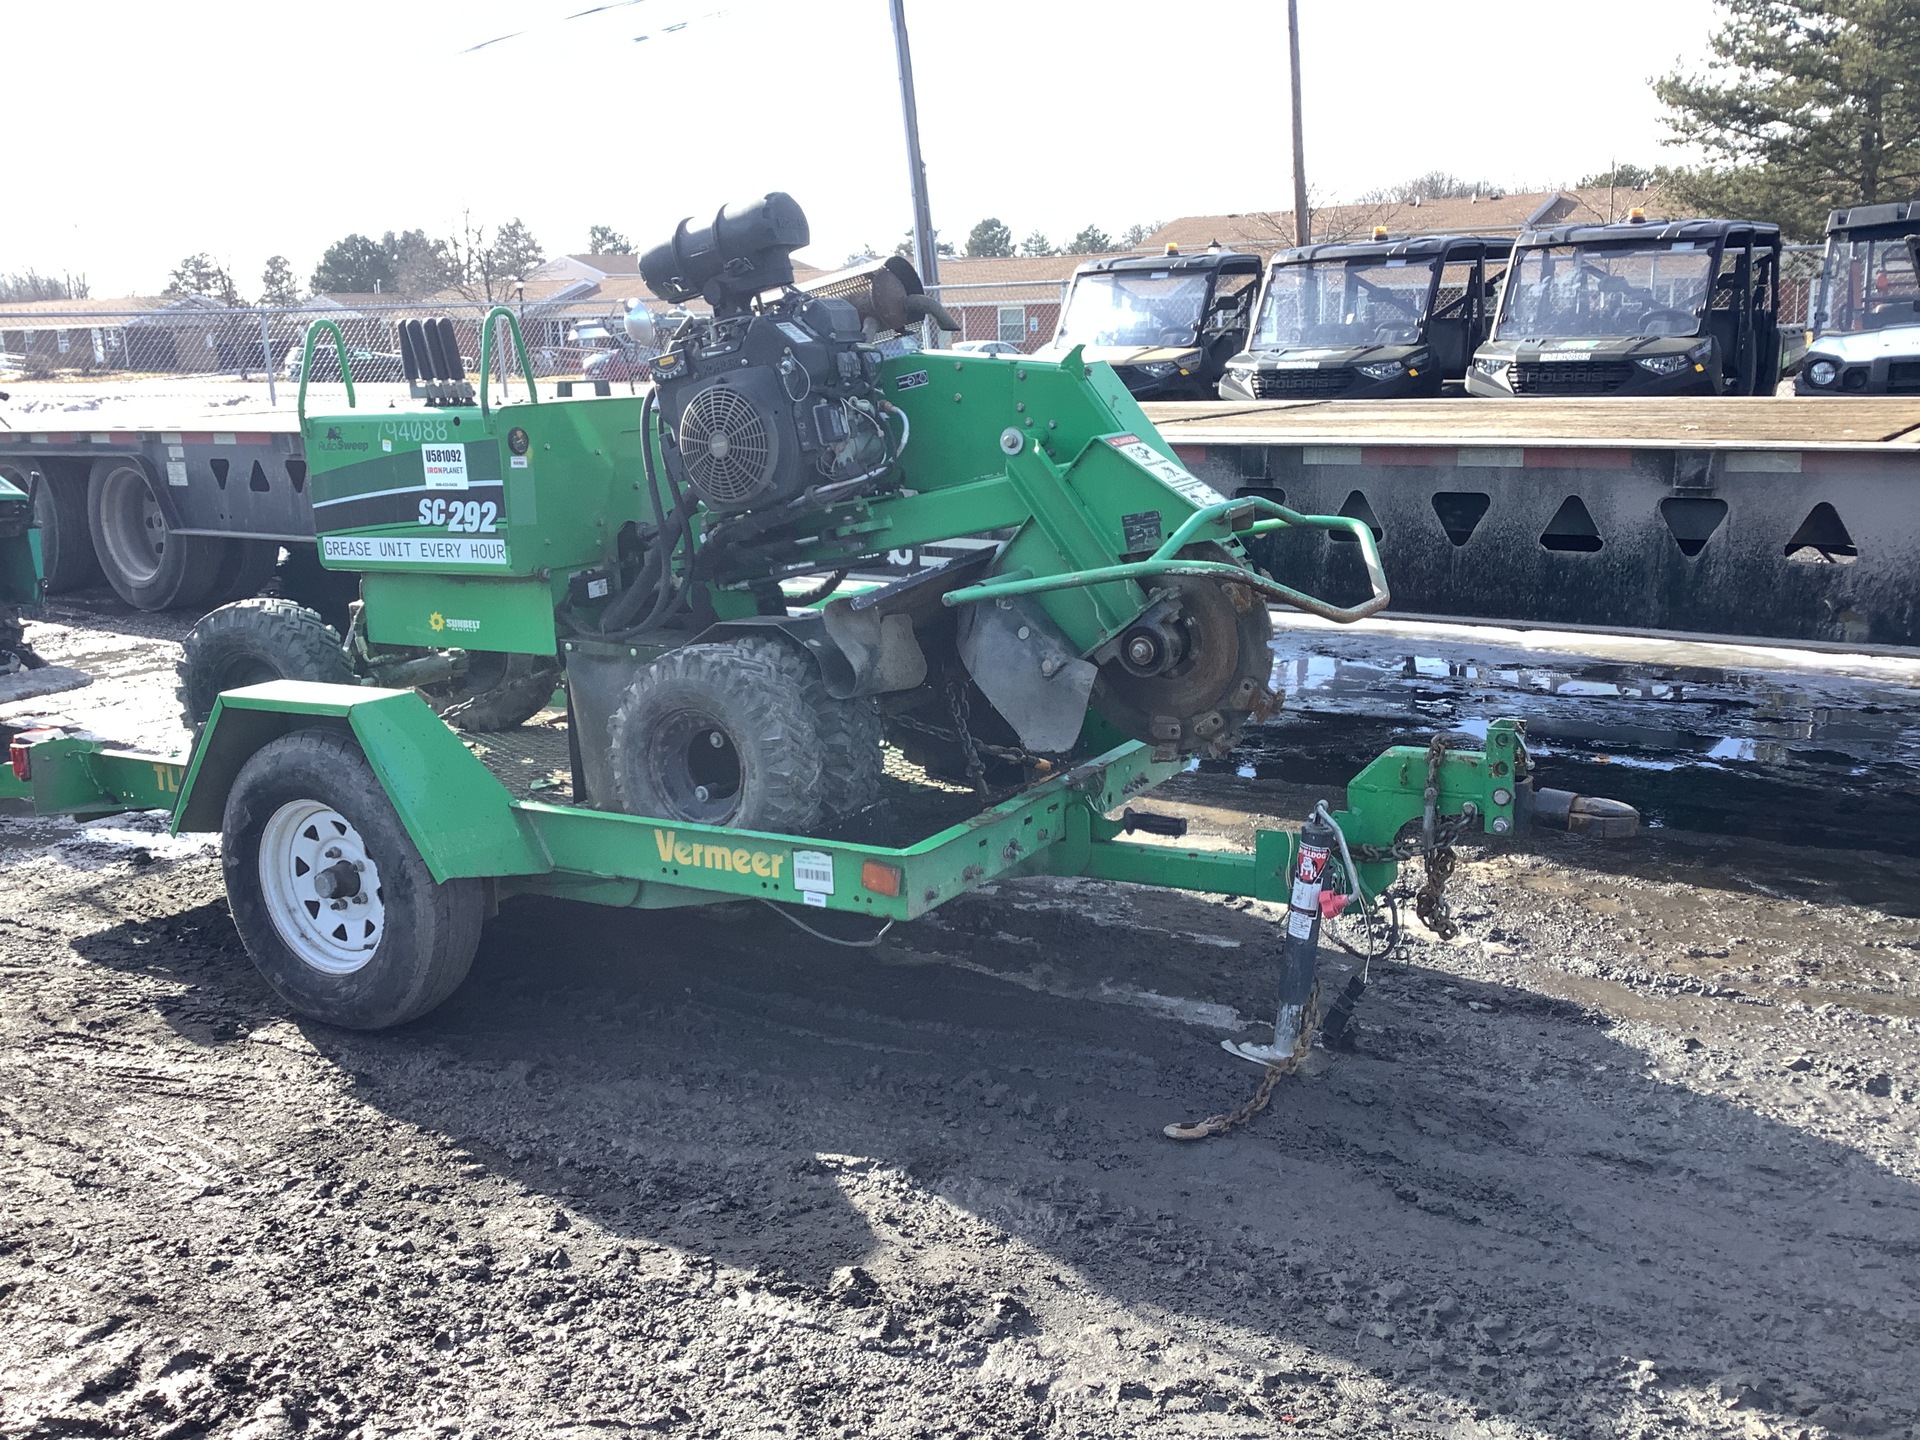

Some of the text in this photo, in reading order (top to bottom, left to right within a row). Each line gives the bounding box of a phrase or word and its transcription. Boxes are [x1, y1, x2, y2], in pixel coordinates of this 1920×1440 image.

[1526, 371, 1604, 383] POLARIS
[1265, 379, 1329, 389] POLARIS
[319, 440, 369, 452] AutoSweep
[425, 449, 462, 462] U581092
[324, 540, 506, 559] GREASE UNIT EVERY HOUR
[445, 618, 481, 629] SUNBELT
[654, 829, 784, 879] Vermeer
